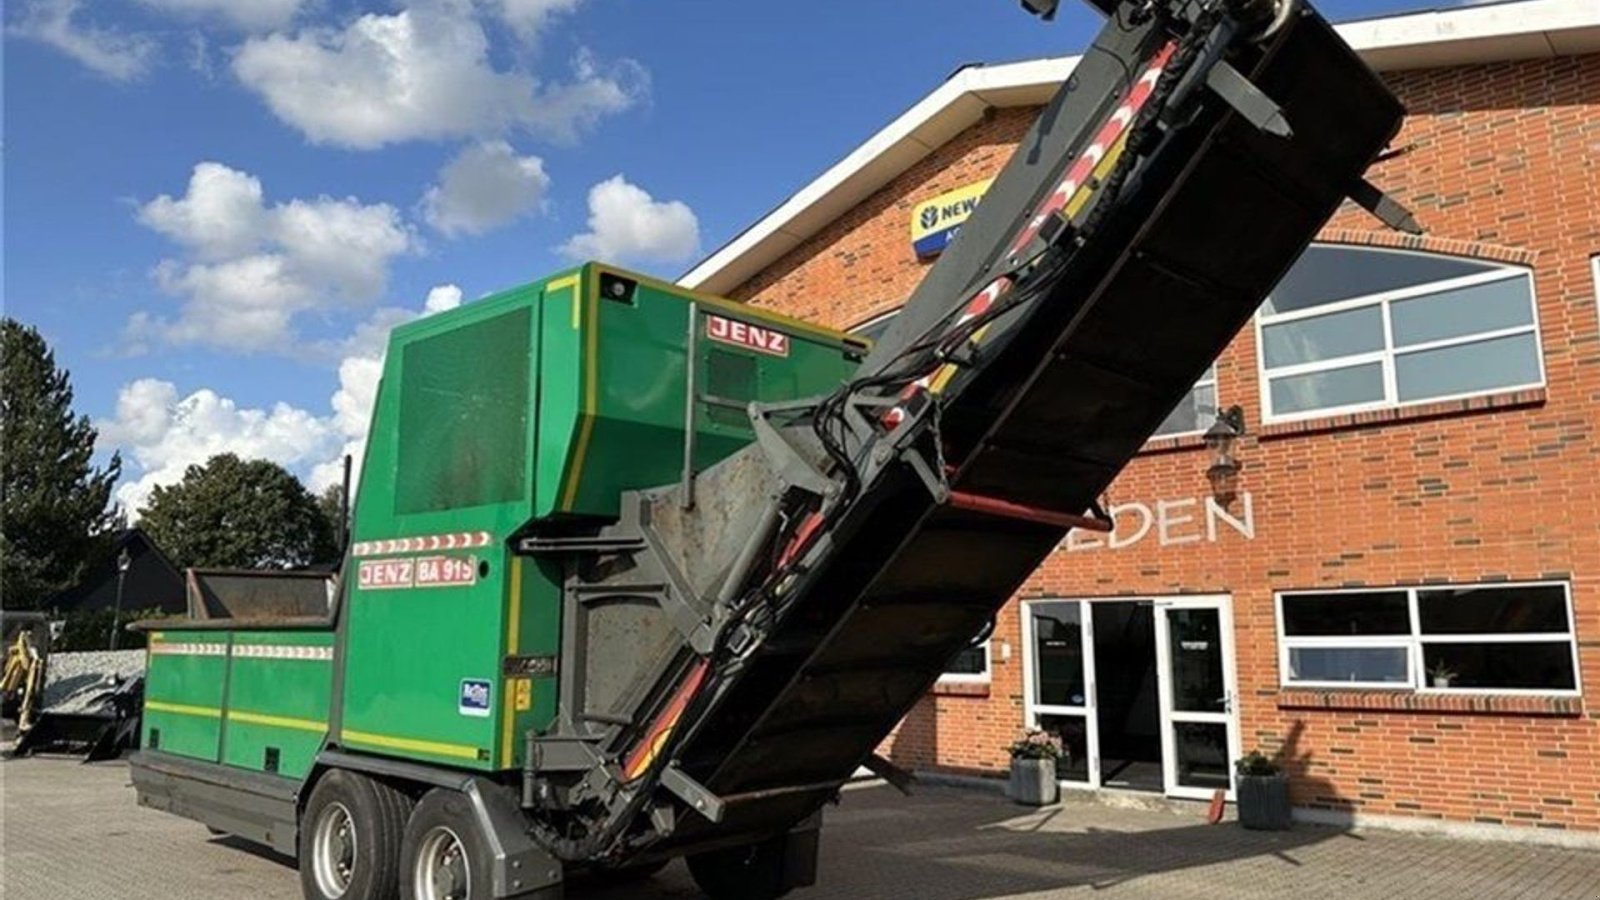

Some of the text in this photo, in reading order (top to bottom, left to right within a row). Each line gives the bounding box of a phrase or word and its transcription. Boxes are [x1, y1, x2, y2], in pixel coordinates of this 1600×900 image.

[711, 315, 785, 352] JENZ
[360, 563, 411, 584] JENZ
[419, 561, 439, 581] BA
